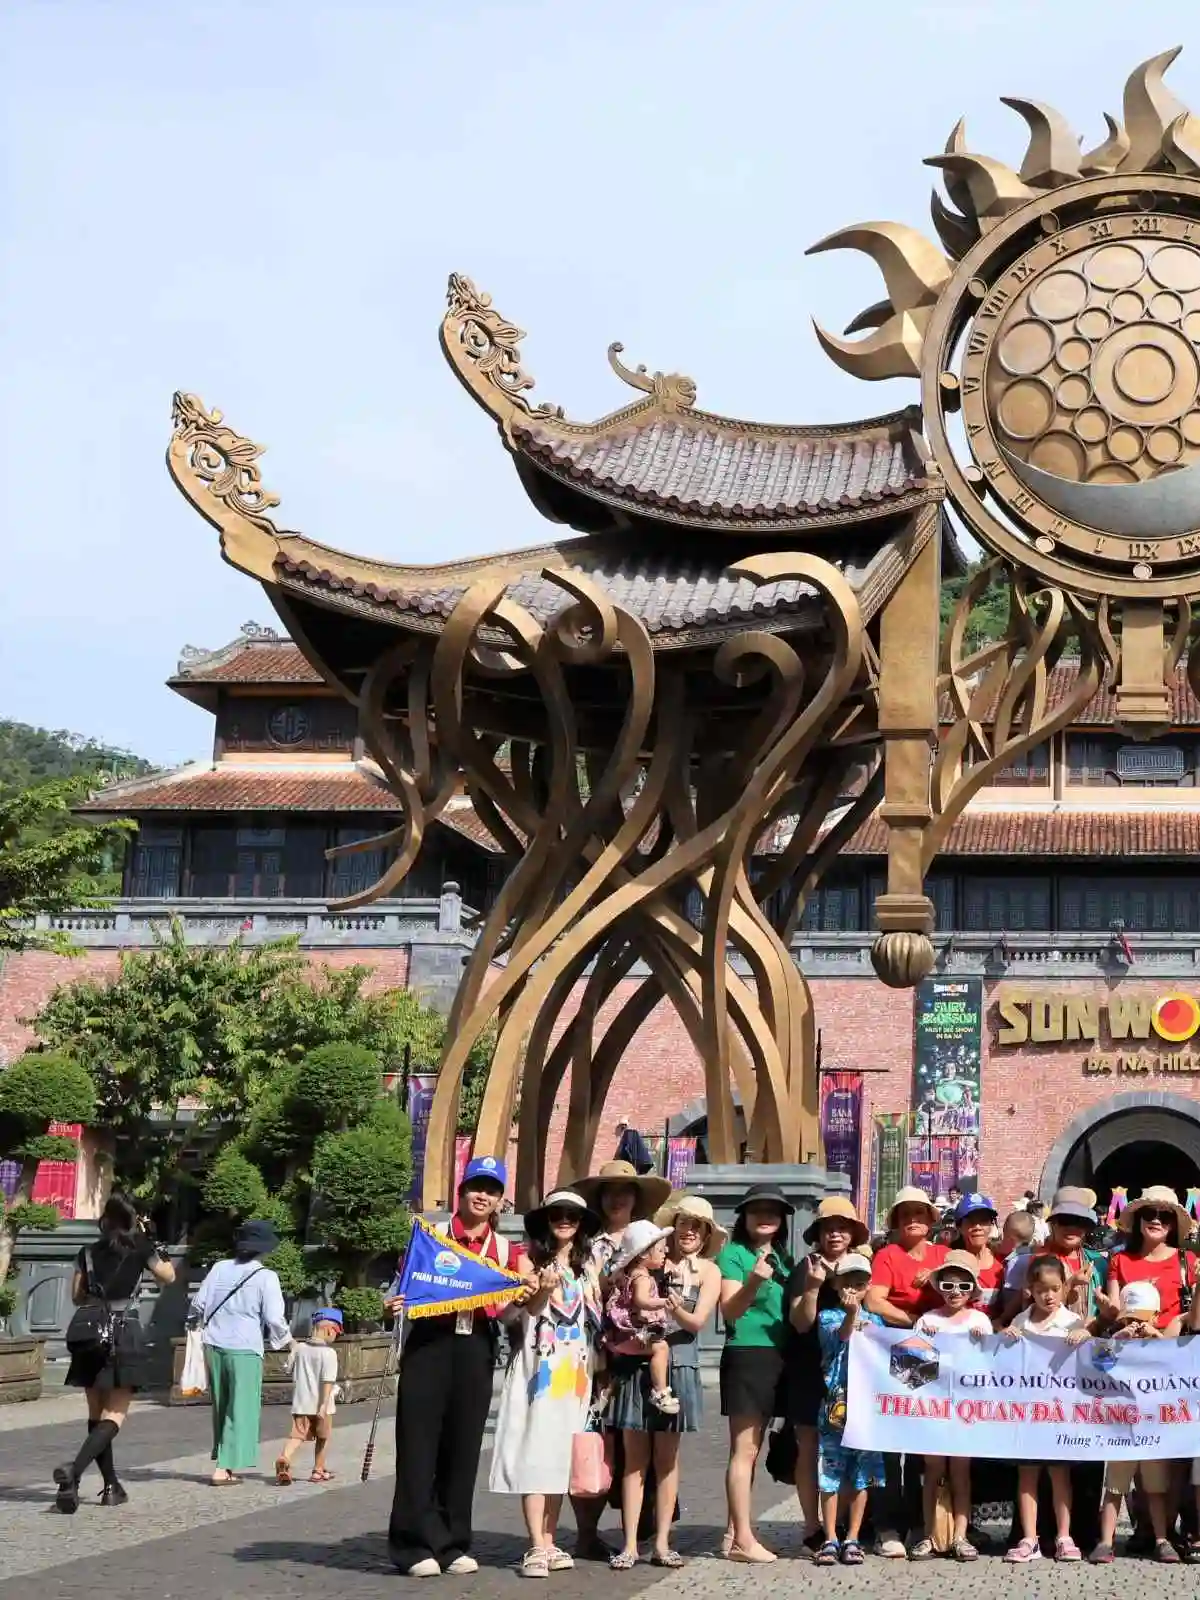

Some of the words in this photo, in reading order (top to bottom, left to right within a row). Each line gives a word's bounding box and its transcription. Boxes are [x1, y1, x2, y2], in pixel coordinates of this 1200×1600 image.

[934, 1001, 966, 1012] FAIRY
[922, 1012, 977, 1024] BLOSSOM
[998, 992, 1101, 1045] SUN
[1087, 1054, 1112, 1071] BA
[1122, 1053, 1148, 1071] NA
[412, 1271, 432, 1282] PHAN
[959, 1371, 1014, 1389] CHÀO
[1019, 1371, 1076, 1389] MỪNG
[877, 1393, 952, 1419] THAM
[956, 1400, 1026, 1424] QUAN
[1031, 1397, 1065, 1422] ĐÀ
[1159, 1398, 1193, 1424] BÀ
[1133, 1435, 1161, 1447] 2024
